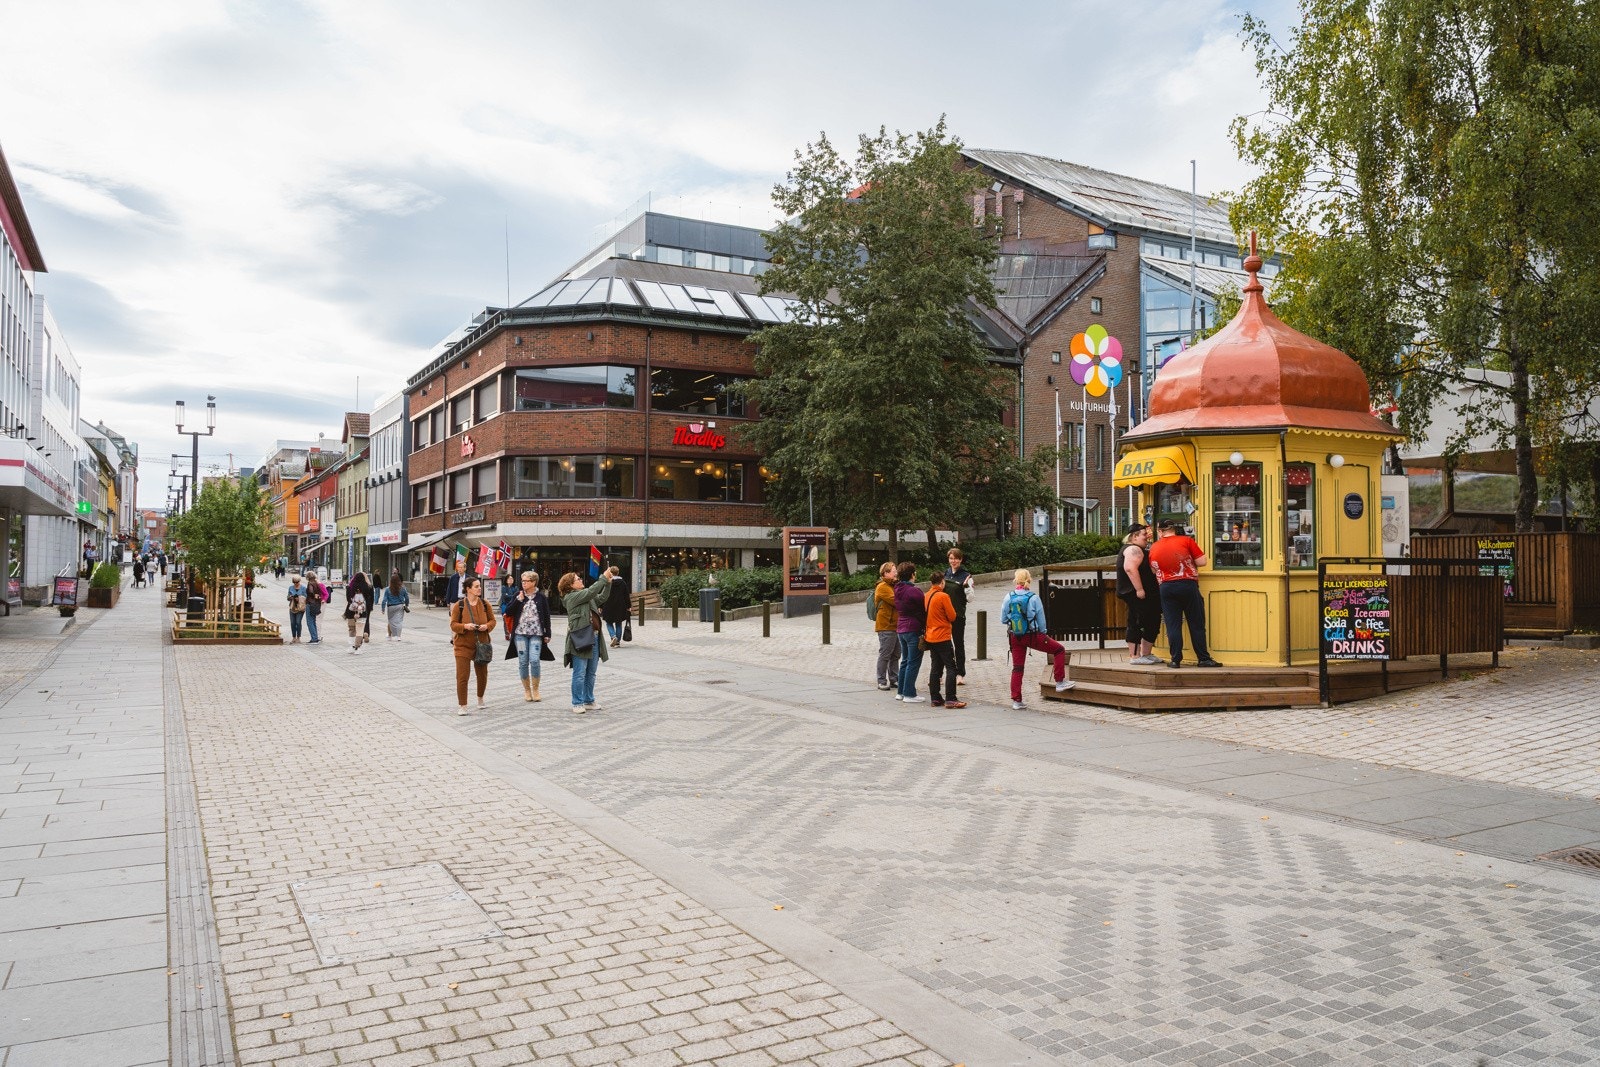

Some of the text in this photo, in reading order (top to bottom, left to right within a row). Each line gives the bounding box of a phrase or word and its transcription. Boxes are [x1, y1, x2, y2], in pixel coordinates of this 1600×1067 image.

[672, 425, 726, 451] Nordlys
[1122, 461, 1155, 477] BAR
[1324, 606, 1348, 617] Cocoa
[1354, 608, 1367, 617] Ice
[1324, 616, 1347, 628] Soda
[1324, 628, 1345, 640] Cold
[1348, 630, 1354, 638] &
[1333, 640, 1385, 653] DRINKS
